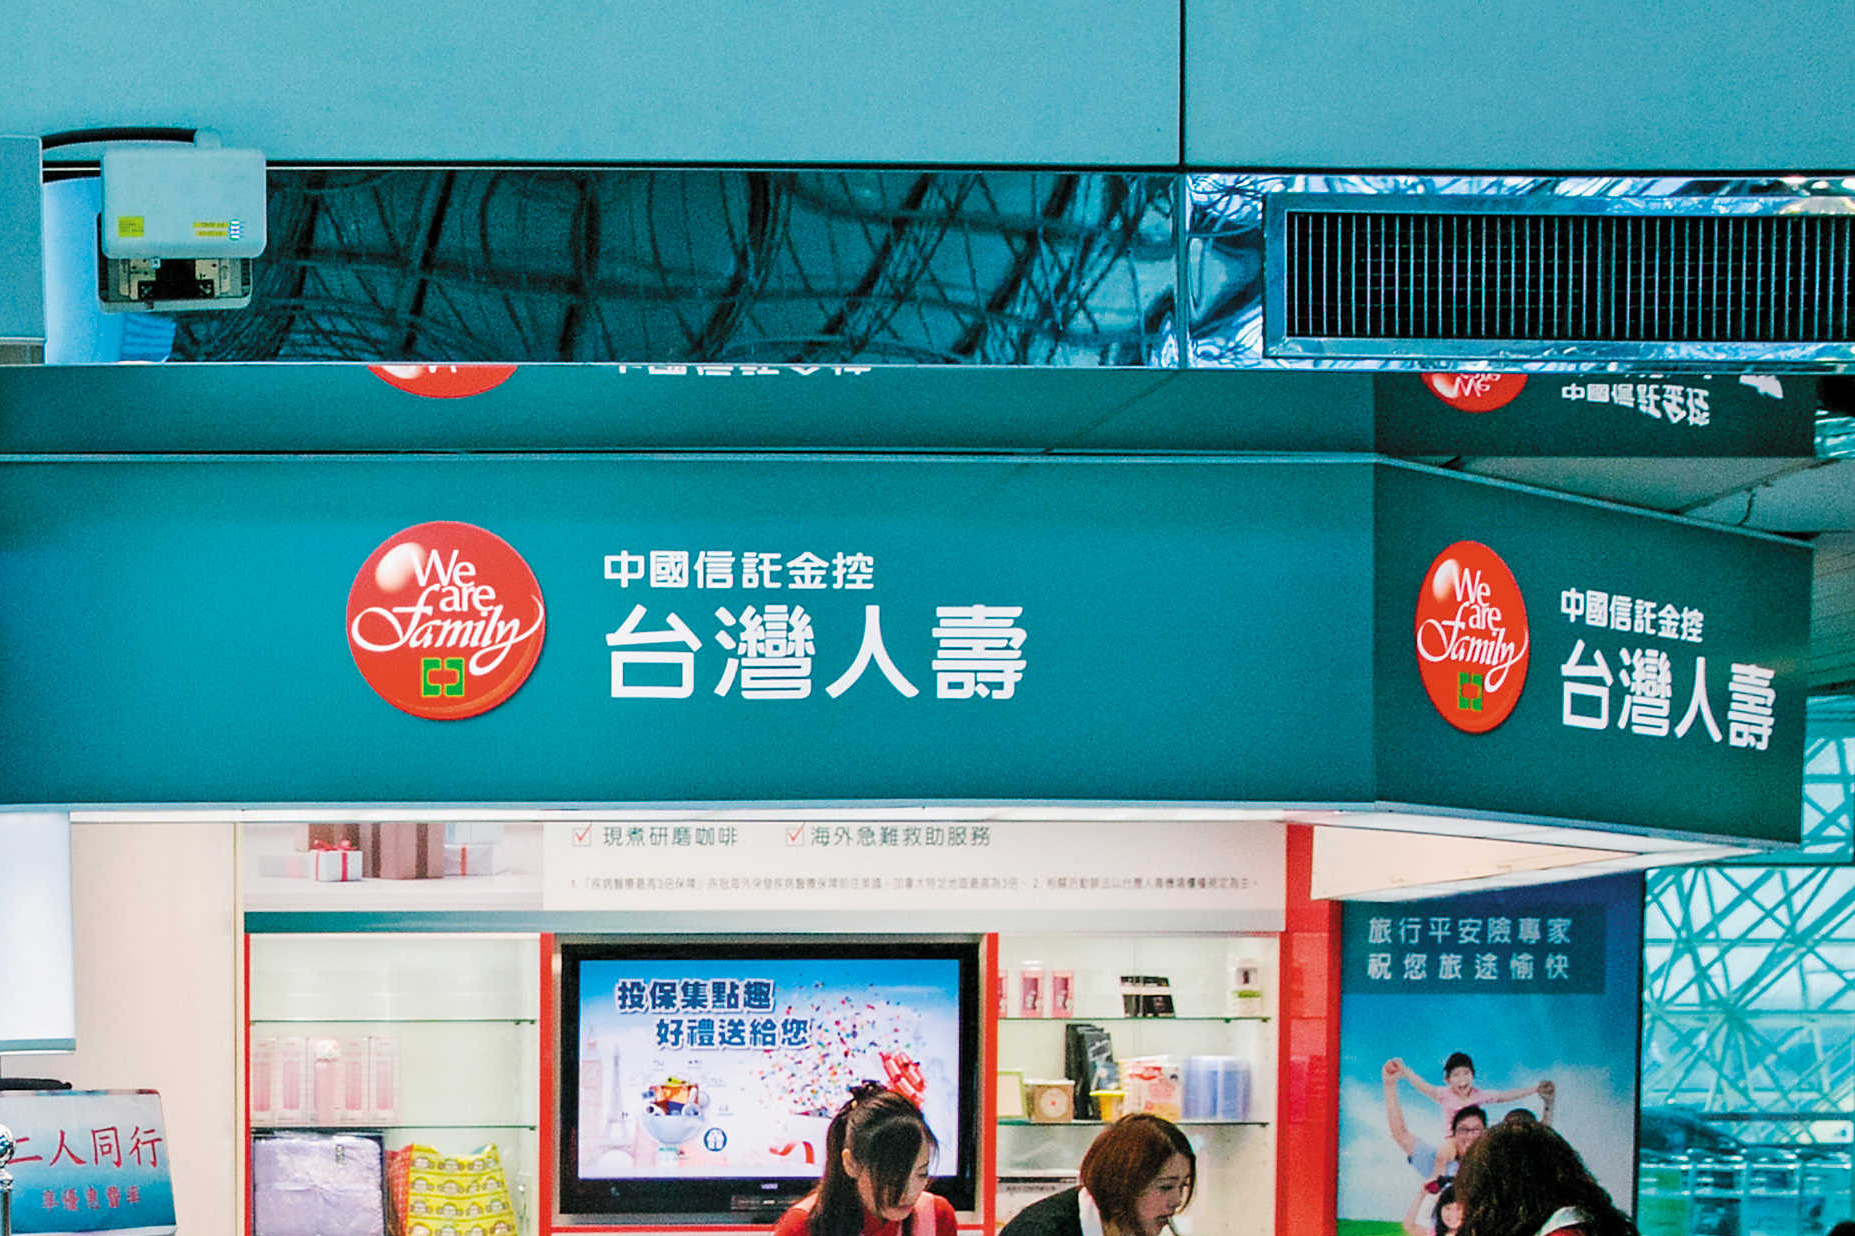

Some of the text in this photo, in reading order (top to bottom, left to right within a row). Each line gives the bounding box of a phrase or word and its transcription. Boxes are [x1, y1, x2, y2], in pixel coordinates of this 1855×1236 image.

[412, 549, 476, 589] We
[604, 550, 874, 590] 中國信託金控
[1453, 567, 1491, 603] We
[442, 582, 496, 613] are
[1561, 587, 1705, 643] 中國信託金控
[351, 594, 542, 676] Family
[1468, 604, 1502, 632] are
[606, 604, 1028, 701] 台灣人壽
[1416, 602, 1527, 693] Family
[1561, 639, 1775, 751] 台灣人壽
[602, 825, 739, 848] 現煮研磨咖啡
[810, 825, 991, 847] 海外急難救助服務
[1367, 917, 1573, 945] 旅行平安險專家
[1366, 952, 1571, 981] 祝您旅途愉快
[616, 978, 775, 1013] 投保集點趣
[655, 1017, 812, 1050] 好禮送給您
[9, 1125, 163, 1169] 二人同行
